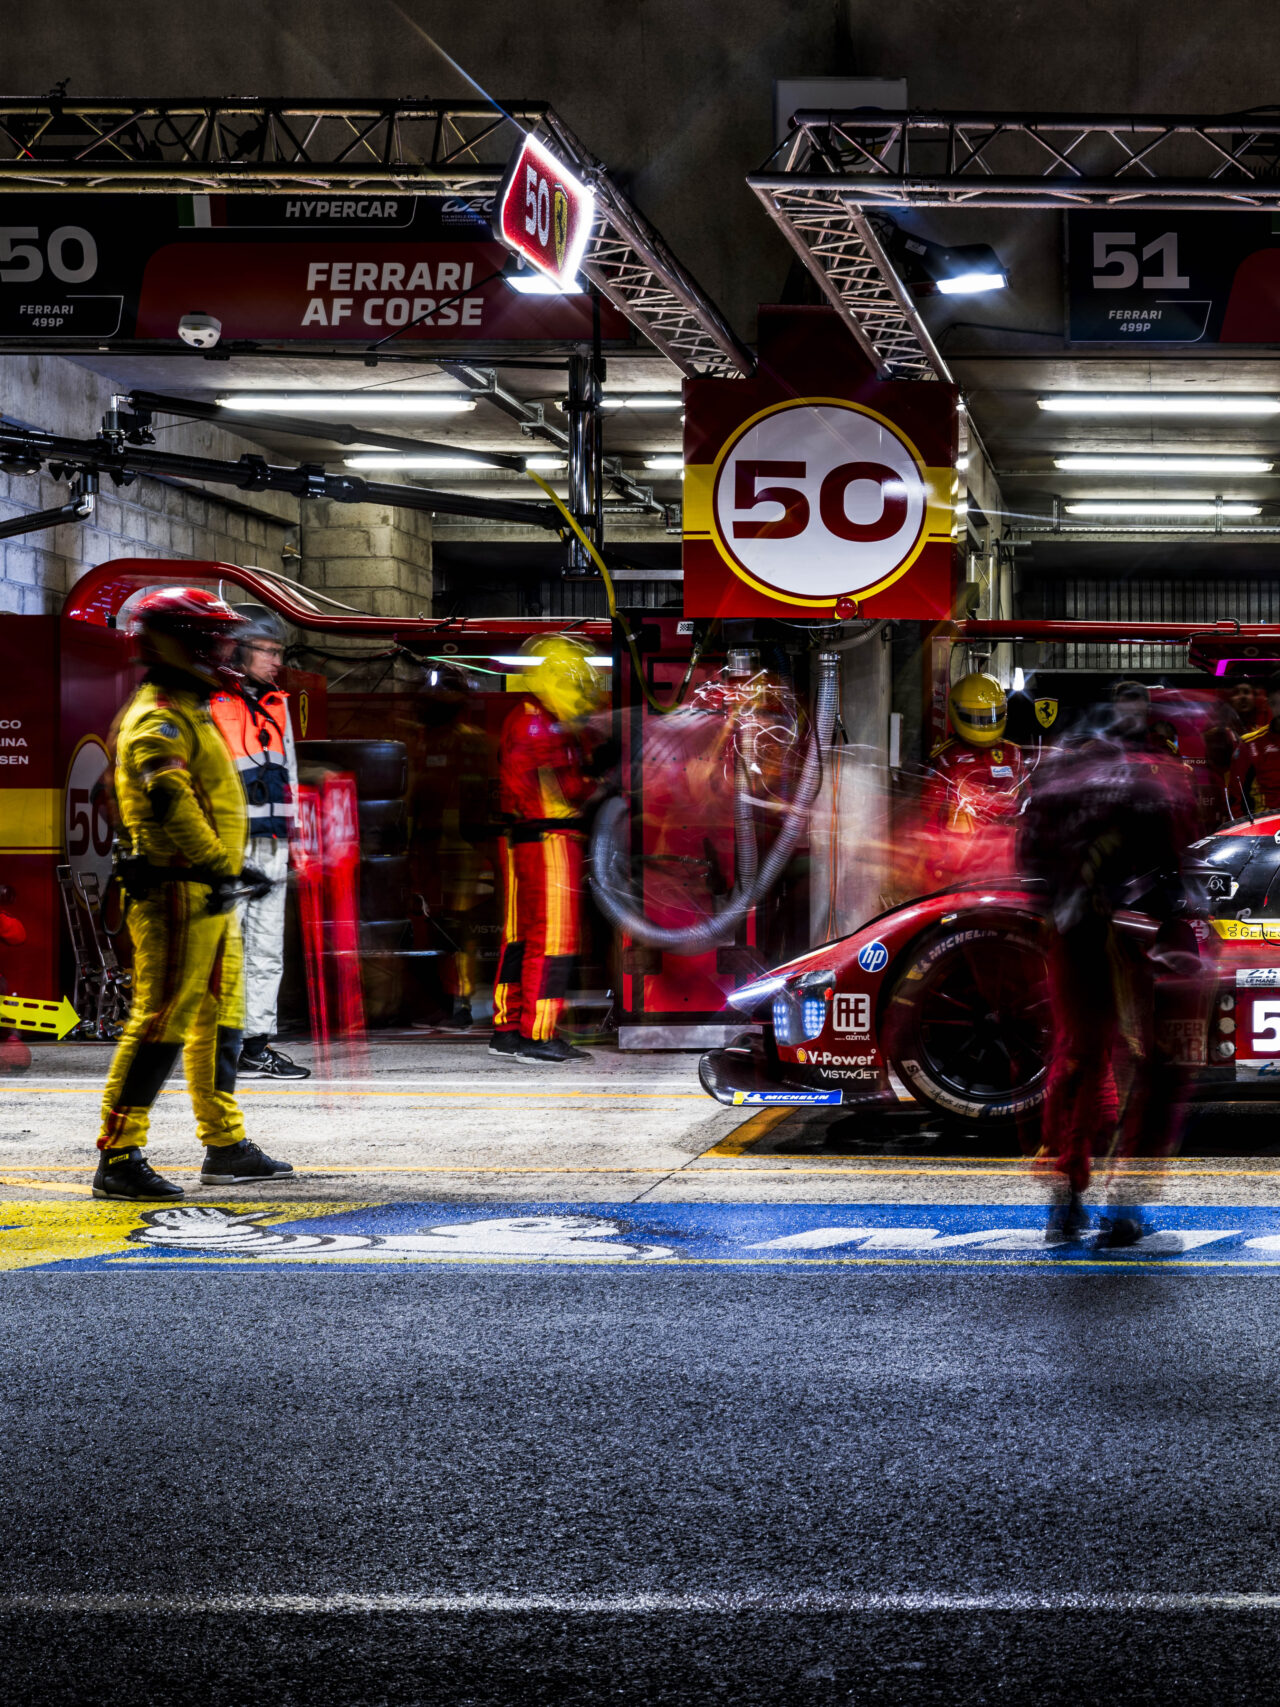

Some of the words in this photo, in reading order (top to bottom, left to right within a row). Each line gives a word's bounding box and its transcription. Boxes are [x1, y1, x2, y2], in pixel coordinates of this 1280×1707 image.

[285, 201, 398, 218] HYPERCAR
[525, 166, 549, 247] 50
[0, 226, 98, 284] 50
[1092, 232, 1190, 289] 51
[307, 262, 474, 291] FERRARI
[20, 305, 74, 315] FERRARI
[32, 318, 64, 327] 499P
[301, 298, 352, 326] AF
[362, 298, 483, 326] CORSE
[1108, 311, 1162, 320] FERRARI
[1120, 323, 1151, 332] 499P
[733, 460, 908, 542] 50
[69, 788, 113, 857] 50
[861, 940, 884, 971] hp
[928, 929, 999, 961] MICHELIN
[845, 1031, 870, 1041] azimut
[808, 1050, 875, 1065] V-Power
